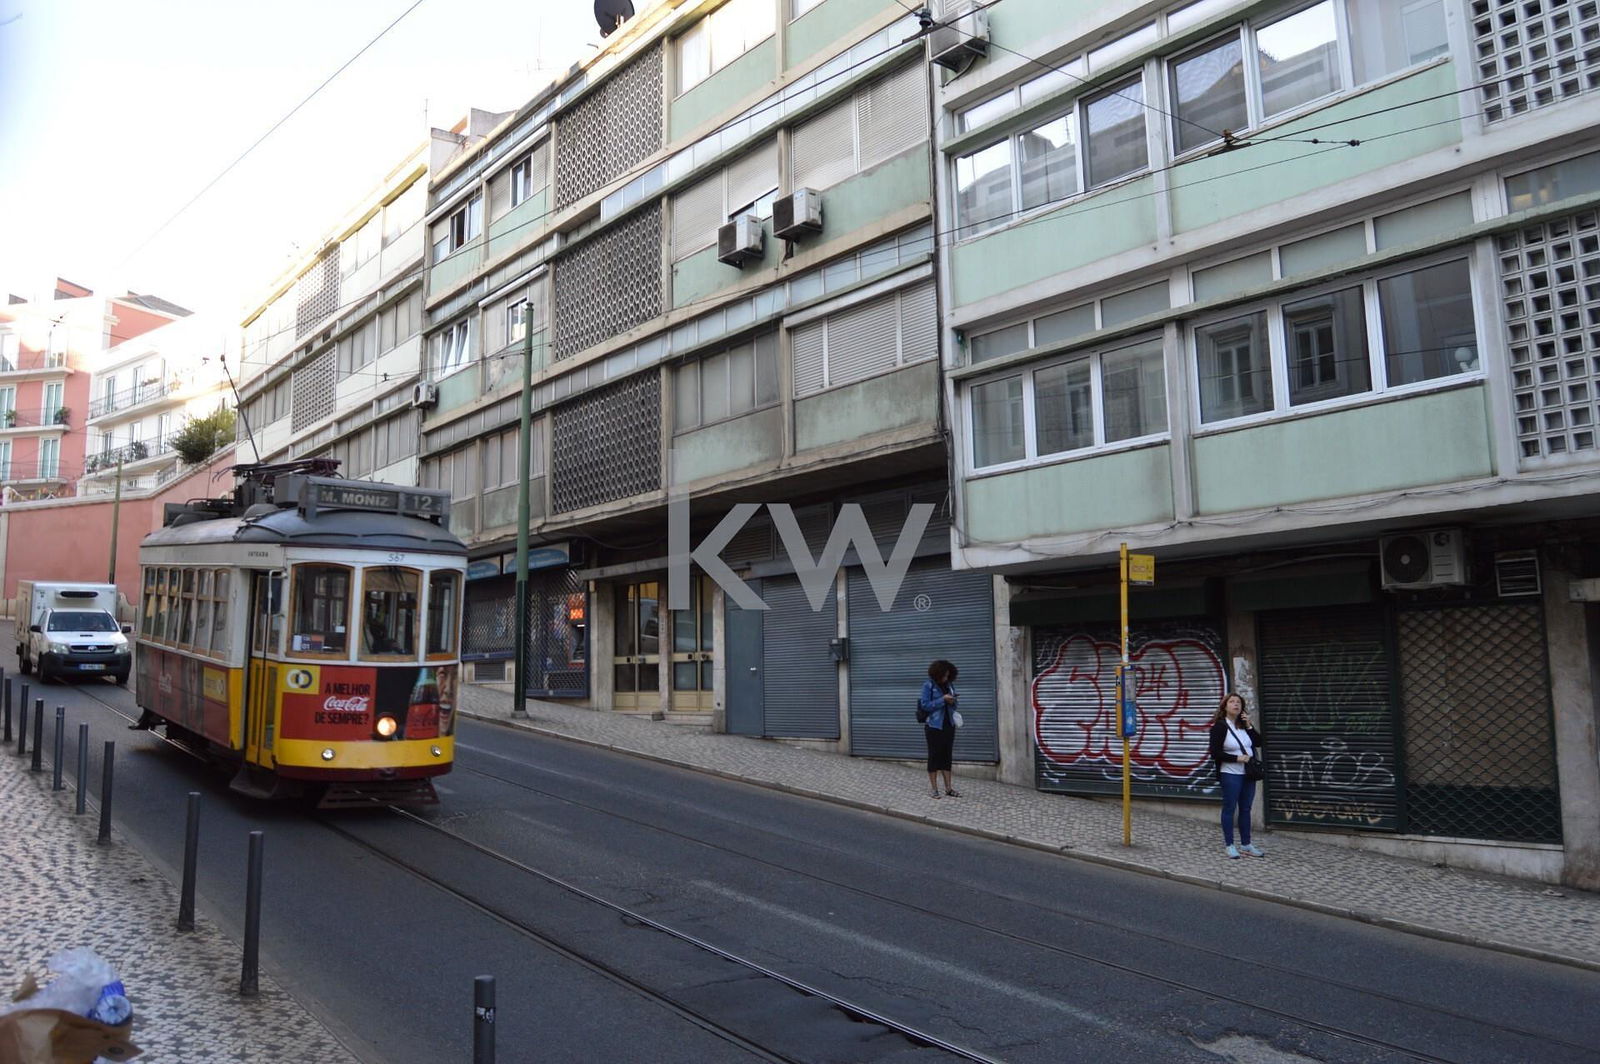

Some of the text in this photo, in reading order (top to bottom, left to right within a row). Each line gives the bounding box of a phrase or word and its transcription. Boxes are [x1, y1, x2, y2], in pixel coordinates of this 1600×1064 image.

[321, 491, 390, 507] M. MONIZ
[414, 495, 433, 511] 12
[388, 552, 405, 562] 567
[324, 682, 370, 696] A MELHOR
[314, 711, 370, 726] DE SEMPRE?
